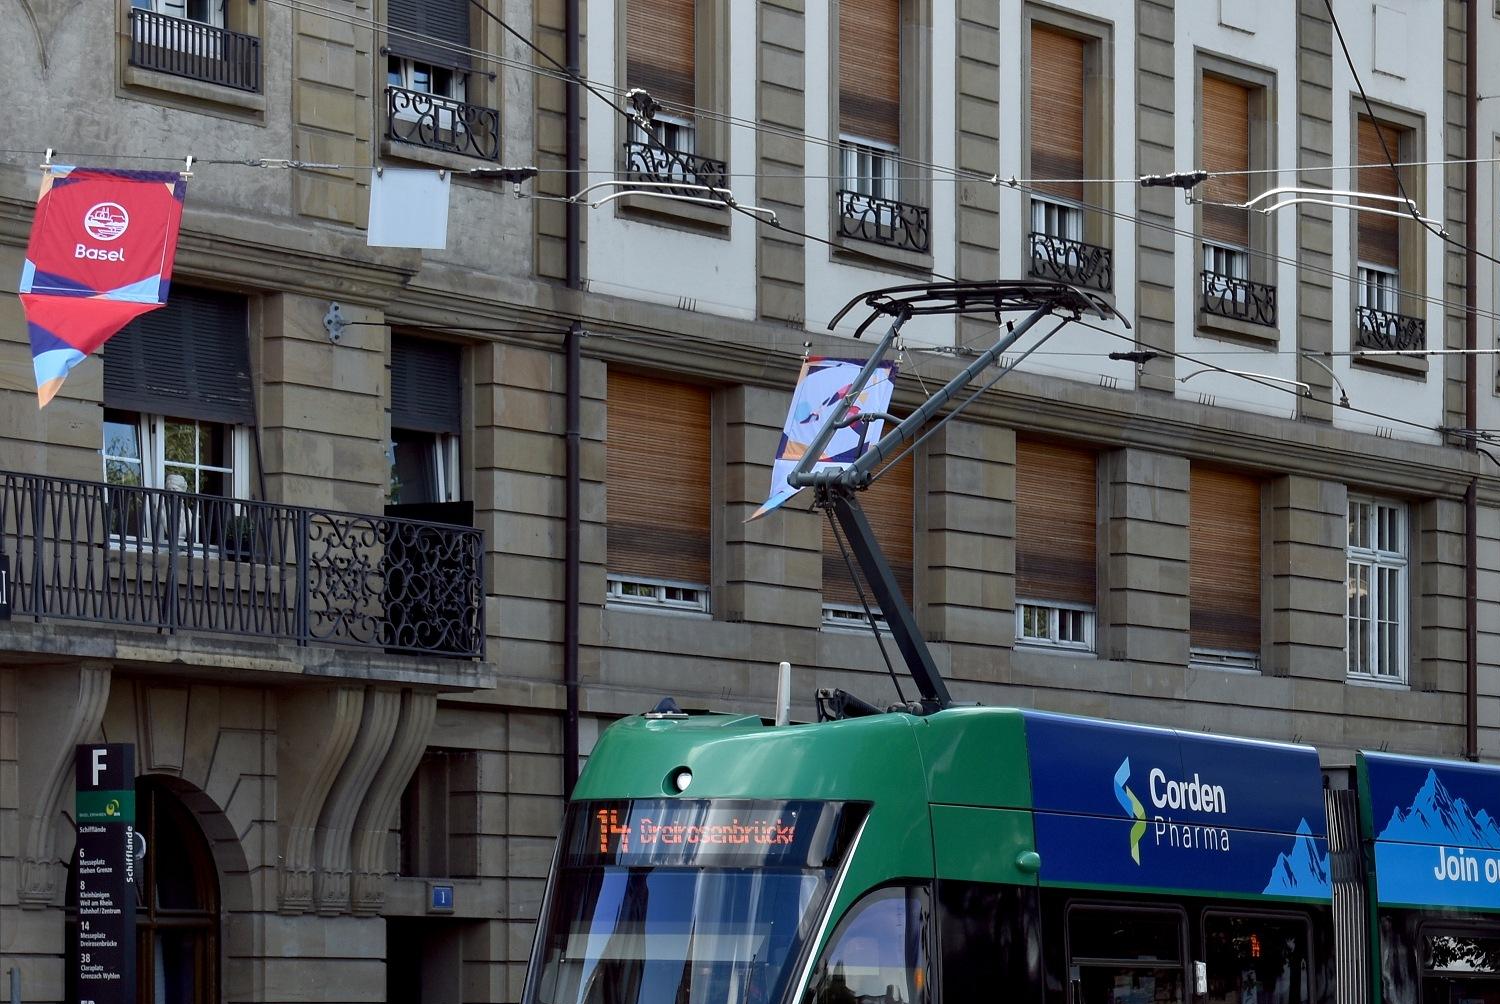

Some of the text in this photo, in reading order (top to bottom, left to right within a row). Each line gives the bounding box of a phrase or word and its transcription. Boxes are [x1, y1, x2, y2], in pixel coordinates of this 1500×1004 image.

[75, 244, 125, 262] Basel
[92, 748, 107, 786] F
[1149, 767, 1227, 814] Corden
[597, 809, 632, 853] 14
[1154, 815, 1230, 852] Pharma
[79, 848, 85, 858] 6
[126, 825, 134, 883] Schifflände
[80, 859, 106, 867] Messeplatz
[1434, 846, 1479, 882] Join
[96, 866, 113, 874] Grenze
[80, 880, 86, 890] 8
[441, 891, 446, 904] 1
[81, 921, 90, 931] 14
[80, 932, 106, 940] Messeplatz
[80, 953, 91, 963] 38
[80, 964, 104, 972] Claraplatz
[102, 972, 120, 981] Wyhlen
